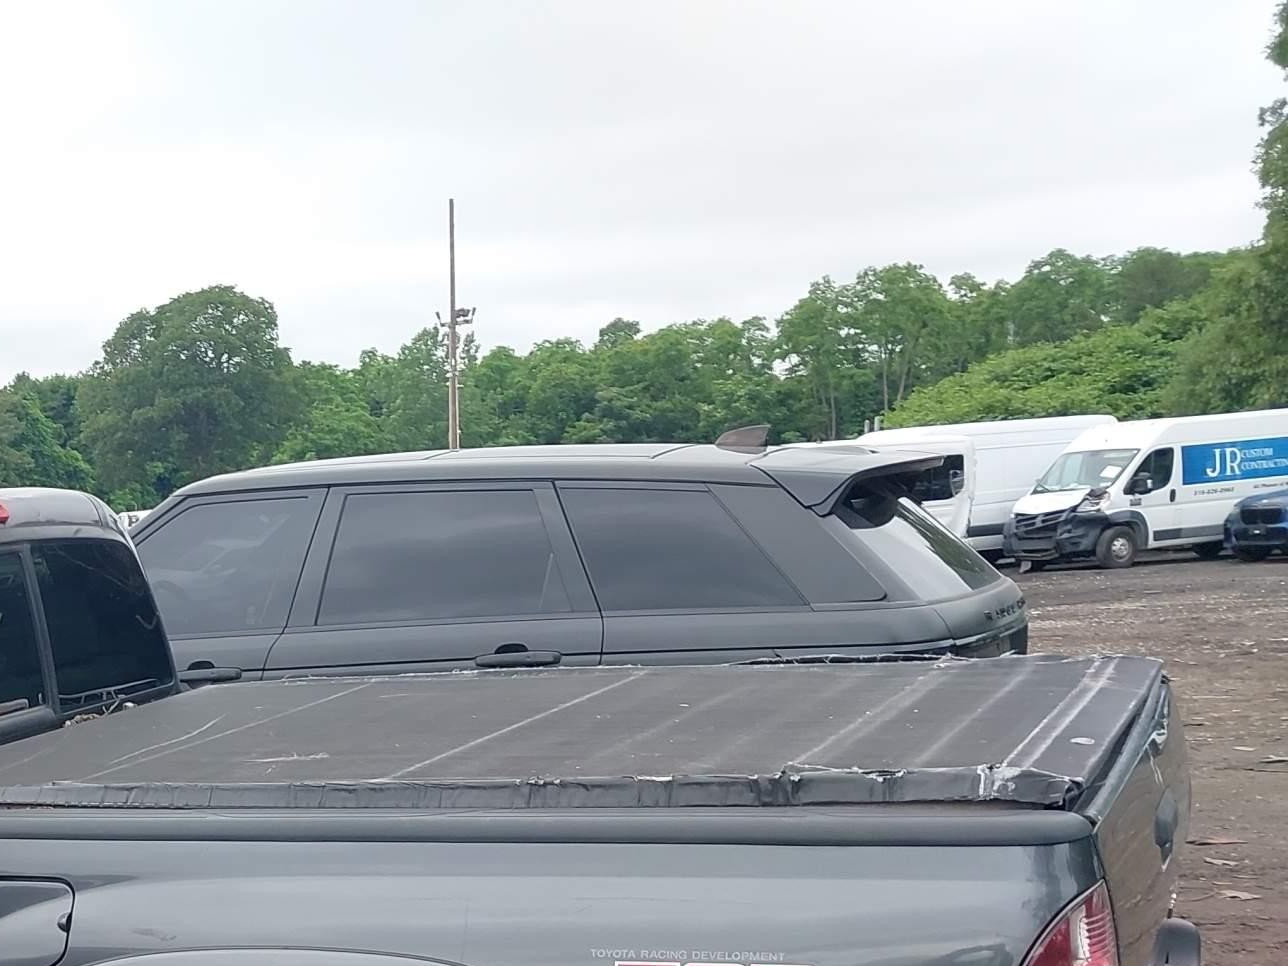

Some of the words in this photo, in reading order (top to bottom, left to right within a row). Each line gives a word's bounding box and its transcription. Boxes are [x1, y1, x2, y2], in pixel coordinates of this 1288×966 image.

[1241, 447, 1274, 458] CUSTOM
[1206, 447, 1241, 478] JR
[590, 949, 637, 960] TOYOTA
[640, 949, 688, 961] RACING
[691, 950, 786, 963] DEVELOPMENT
